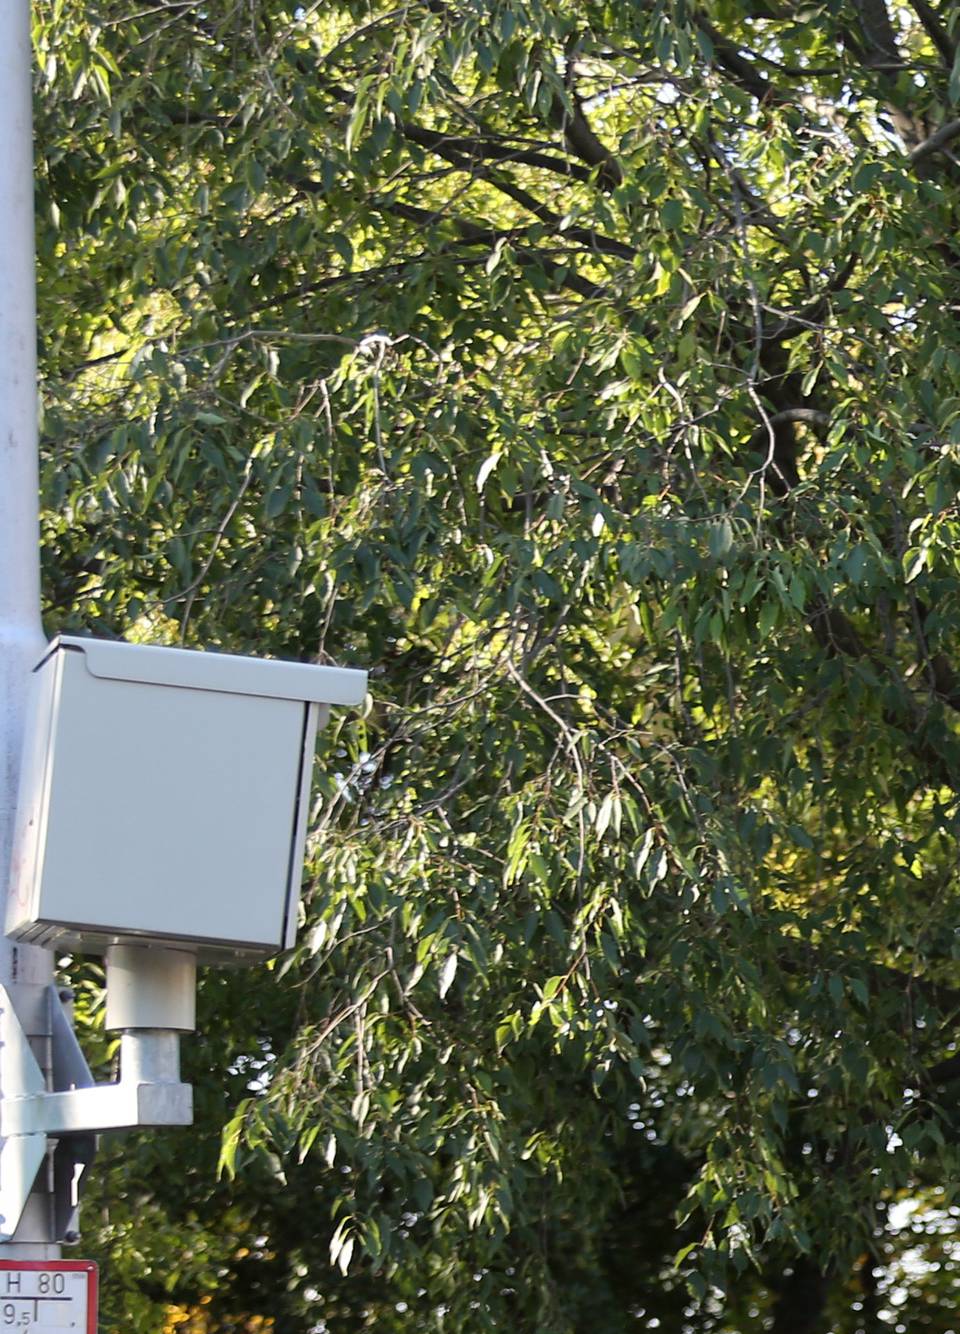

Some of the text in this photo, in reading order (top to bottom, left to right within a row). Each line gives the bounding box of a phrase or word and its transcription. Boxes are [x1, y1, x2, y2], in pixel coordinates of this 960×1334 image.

[7, 1272, 65, 1294] H 80
[3, 1303, 31, 1326] 9,5
